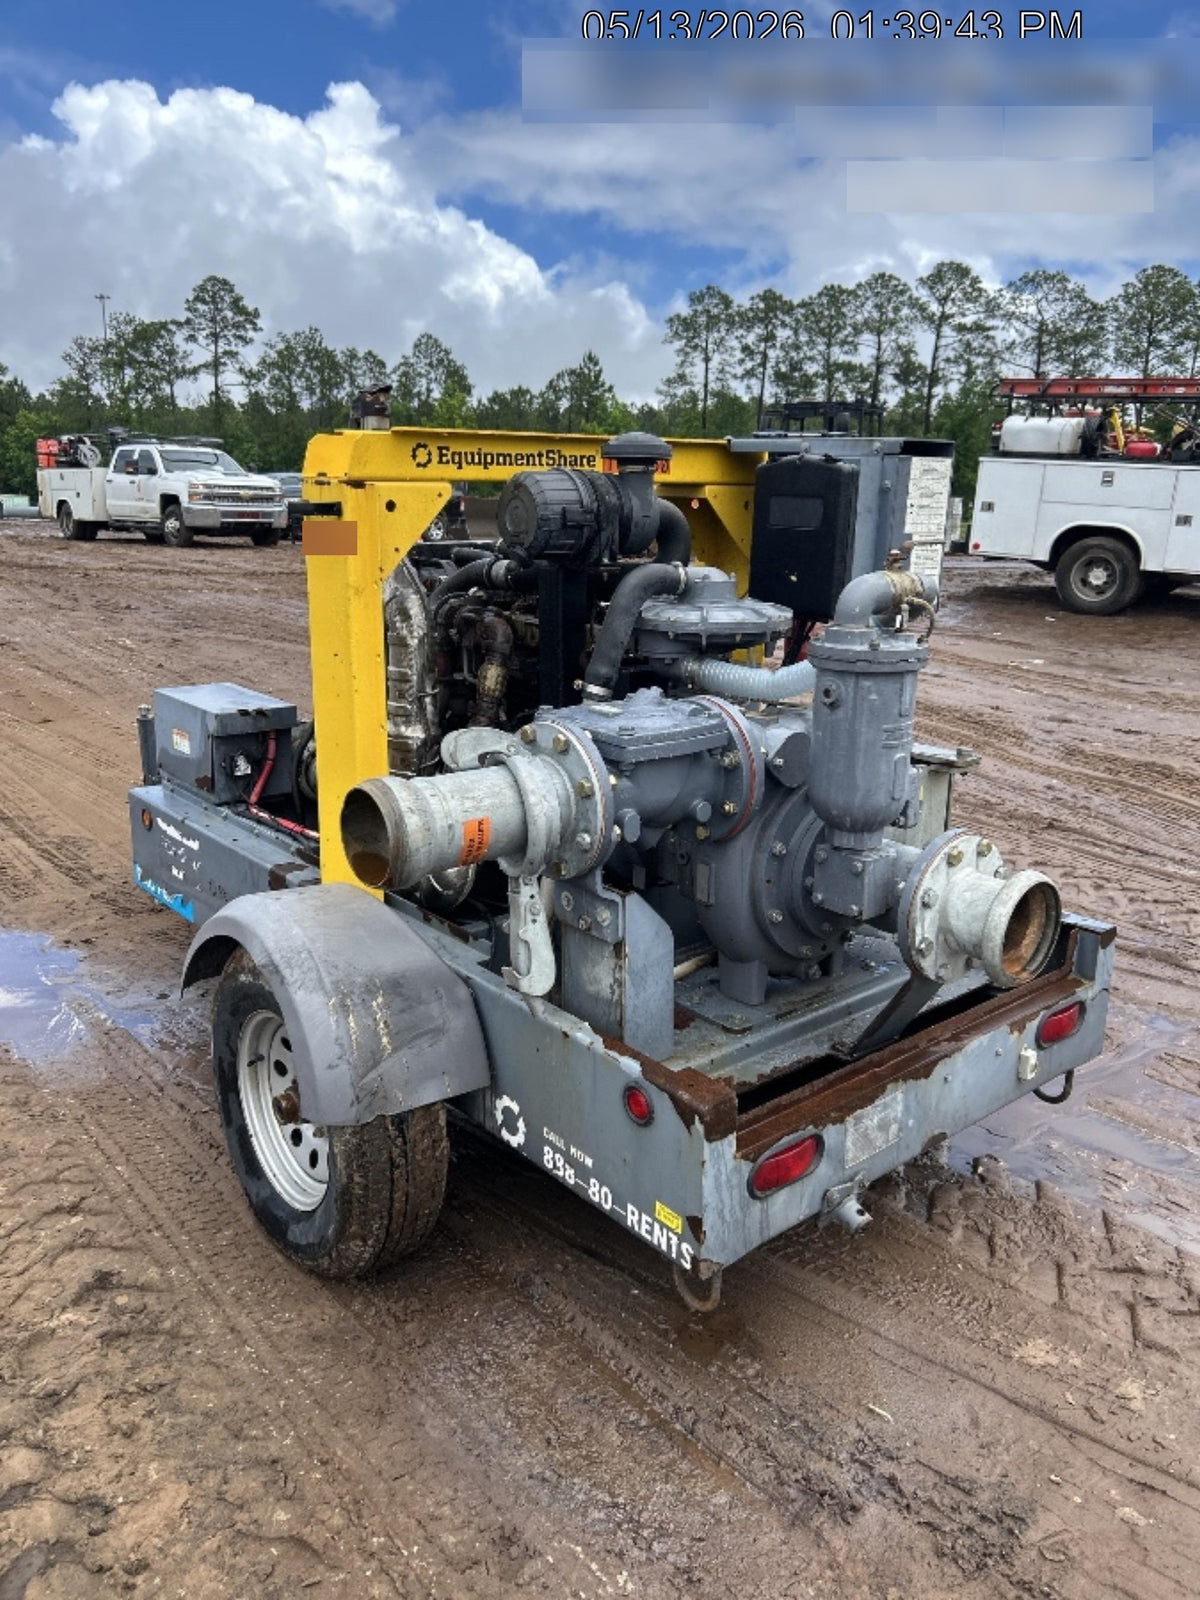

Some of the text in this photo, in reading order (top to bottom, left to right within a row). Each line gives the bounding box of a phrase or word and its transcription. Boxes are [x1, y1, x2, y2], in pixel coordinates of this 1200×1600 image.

[437, 446, 596, 470] EquipmentShare
[543, 1127, 594, 1169] CALL NOW
